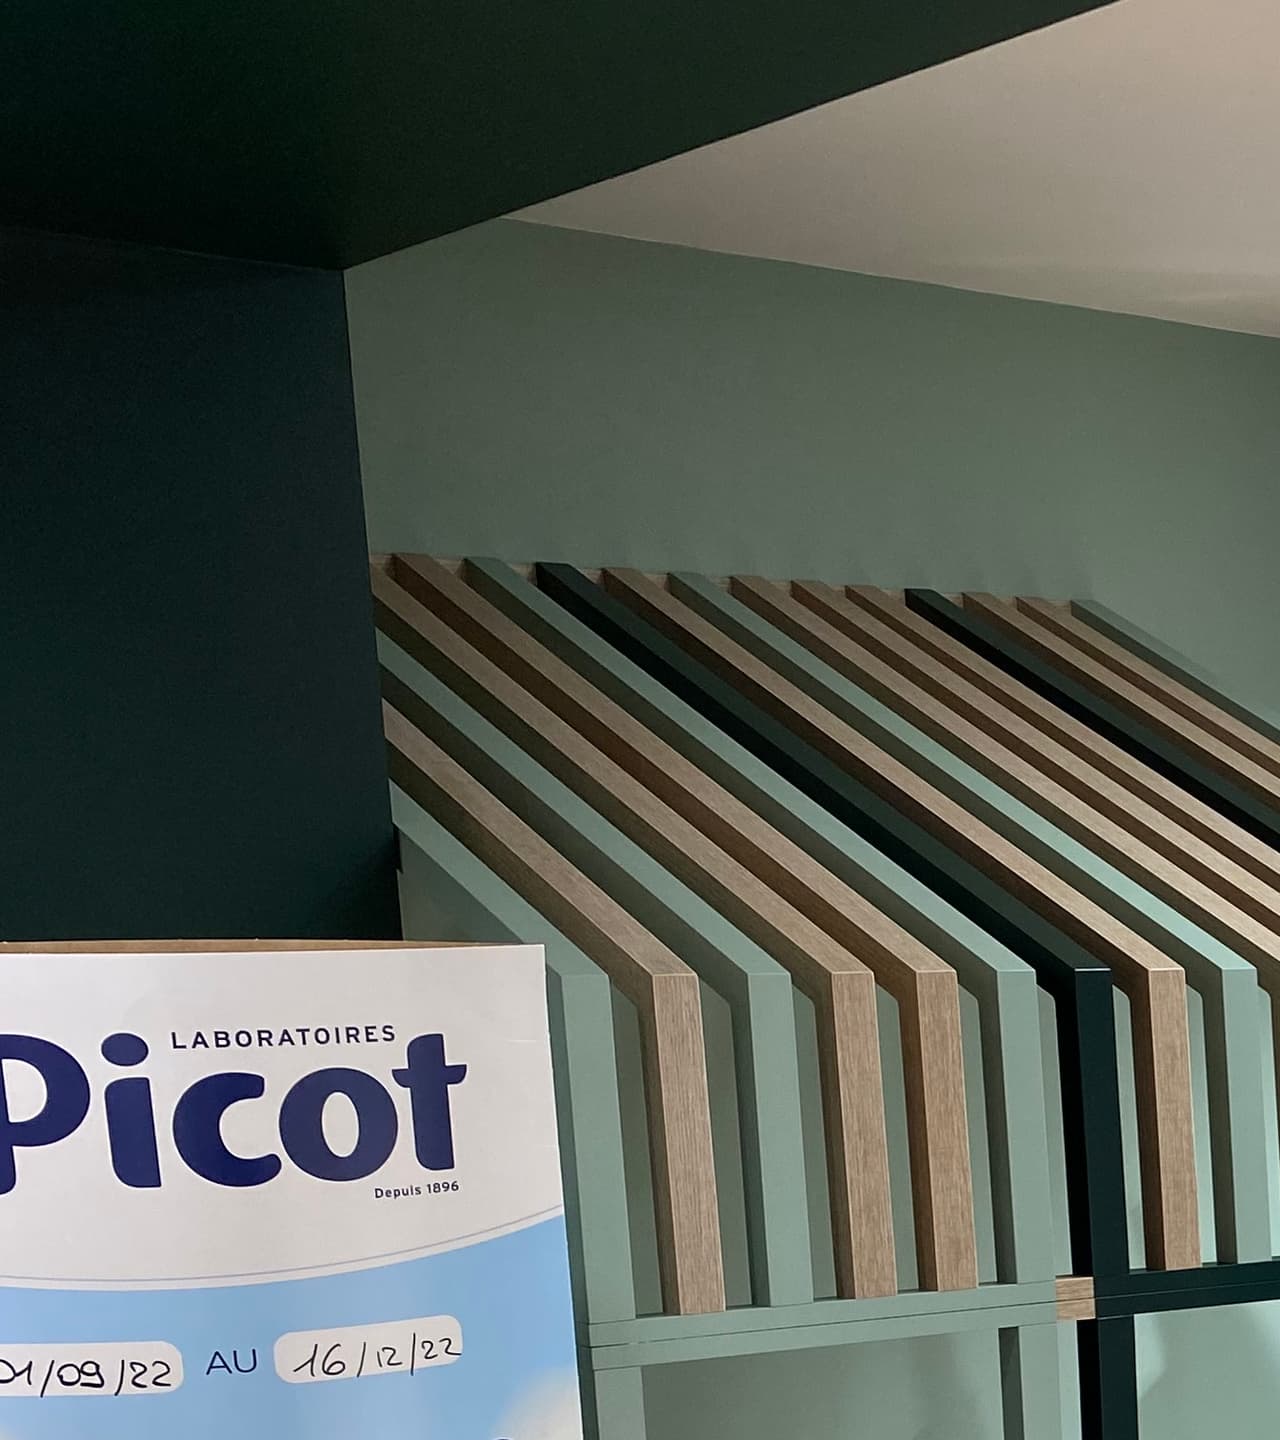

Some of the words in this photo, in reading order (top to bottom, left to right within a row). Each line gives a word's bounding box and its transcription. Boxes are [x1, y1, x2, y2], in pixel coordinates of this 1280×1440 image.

[171, 1024, 396, 1049] LABORATOIRES
[0, 1031, 468, 1196] Picot
[374, 1184, 423, 1200] Depuis
[426, 1179, 460, 1195] 1896
[206, 1349, 258, 1374] AU
[292, 1335, 462, 1379] 16/12/22
